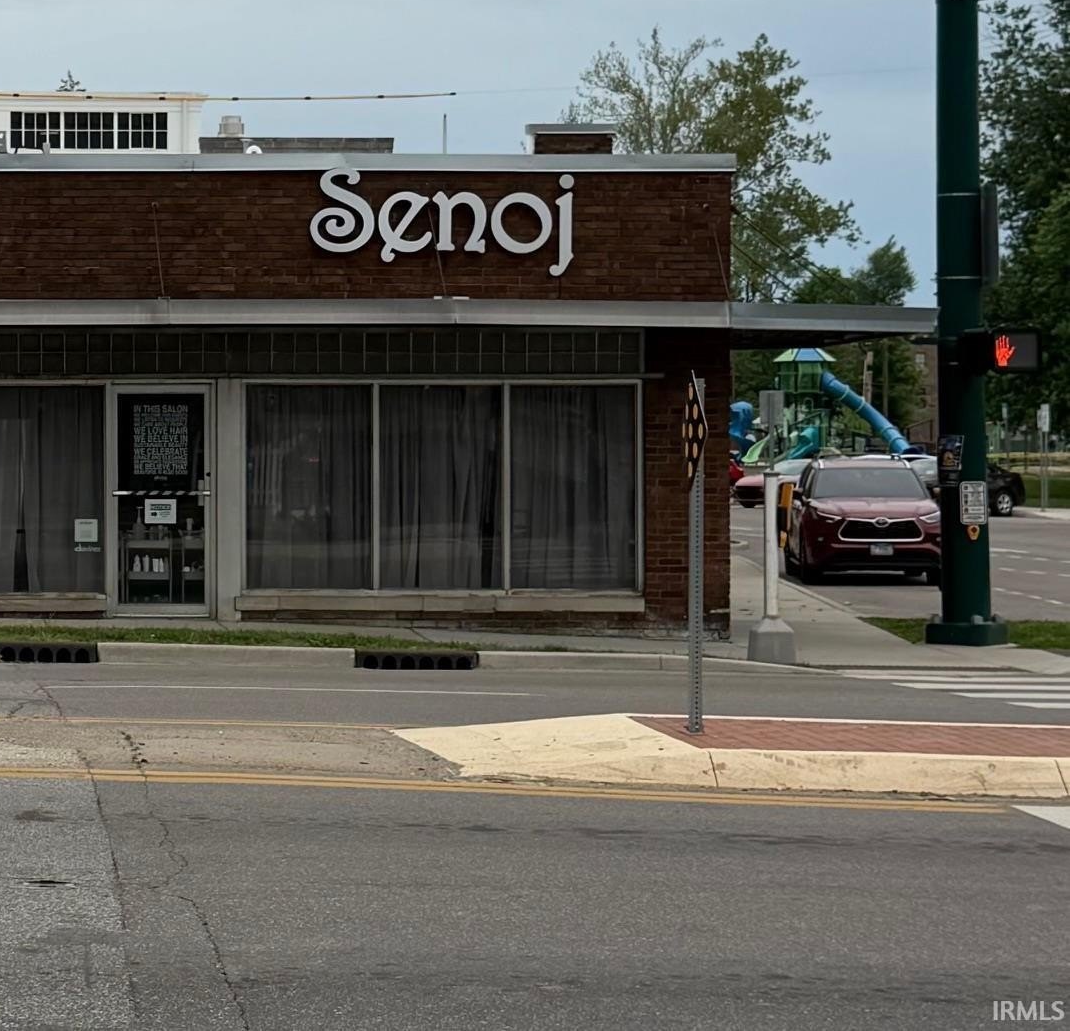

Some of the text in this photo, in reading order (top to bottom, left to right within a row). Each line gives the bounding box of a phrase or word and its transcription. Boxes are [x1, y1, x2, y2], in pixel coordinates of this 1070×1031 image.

[310, 168, 575, 277] Senoj
[162, 404, 188, 413] SALON
[134, 426, 146, 435] WE
[148, 426, 167, 435] LOVE
[148, 434, 179, 443] BELIEVE
